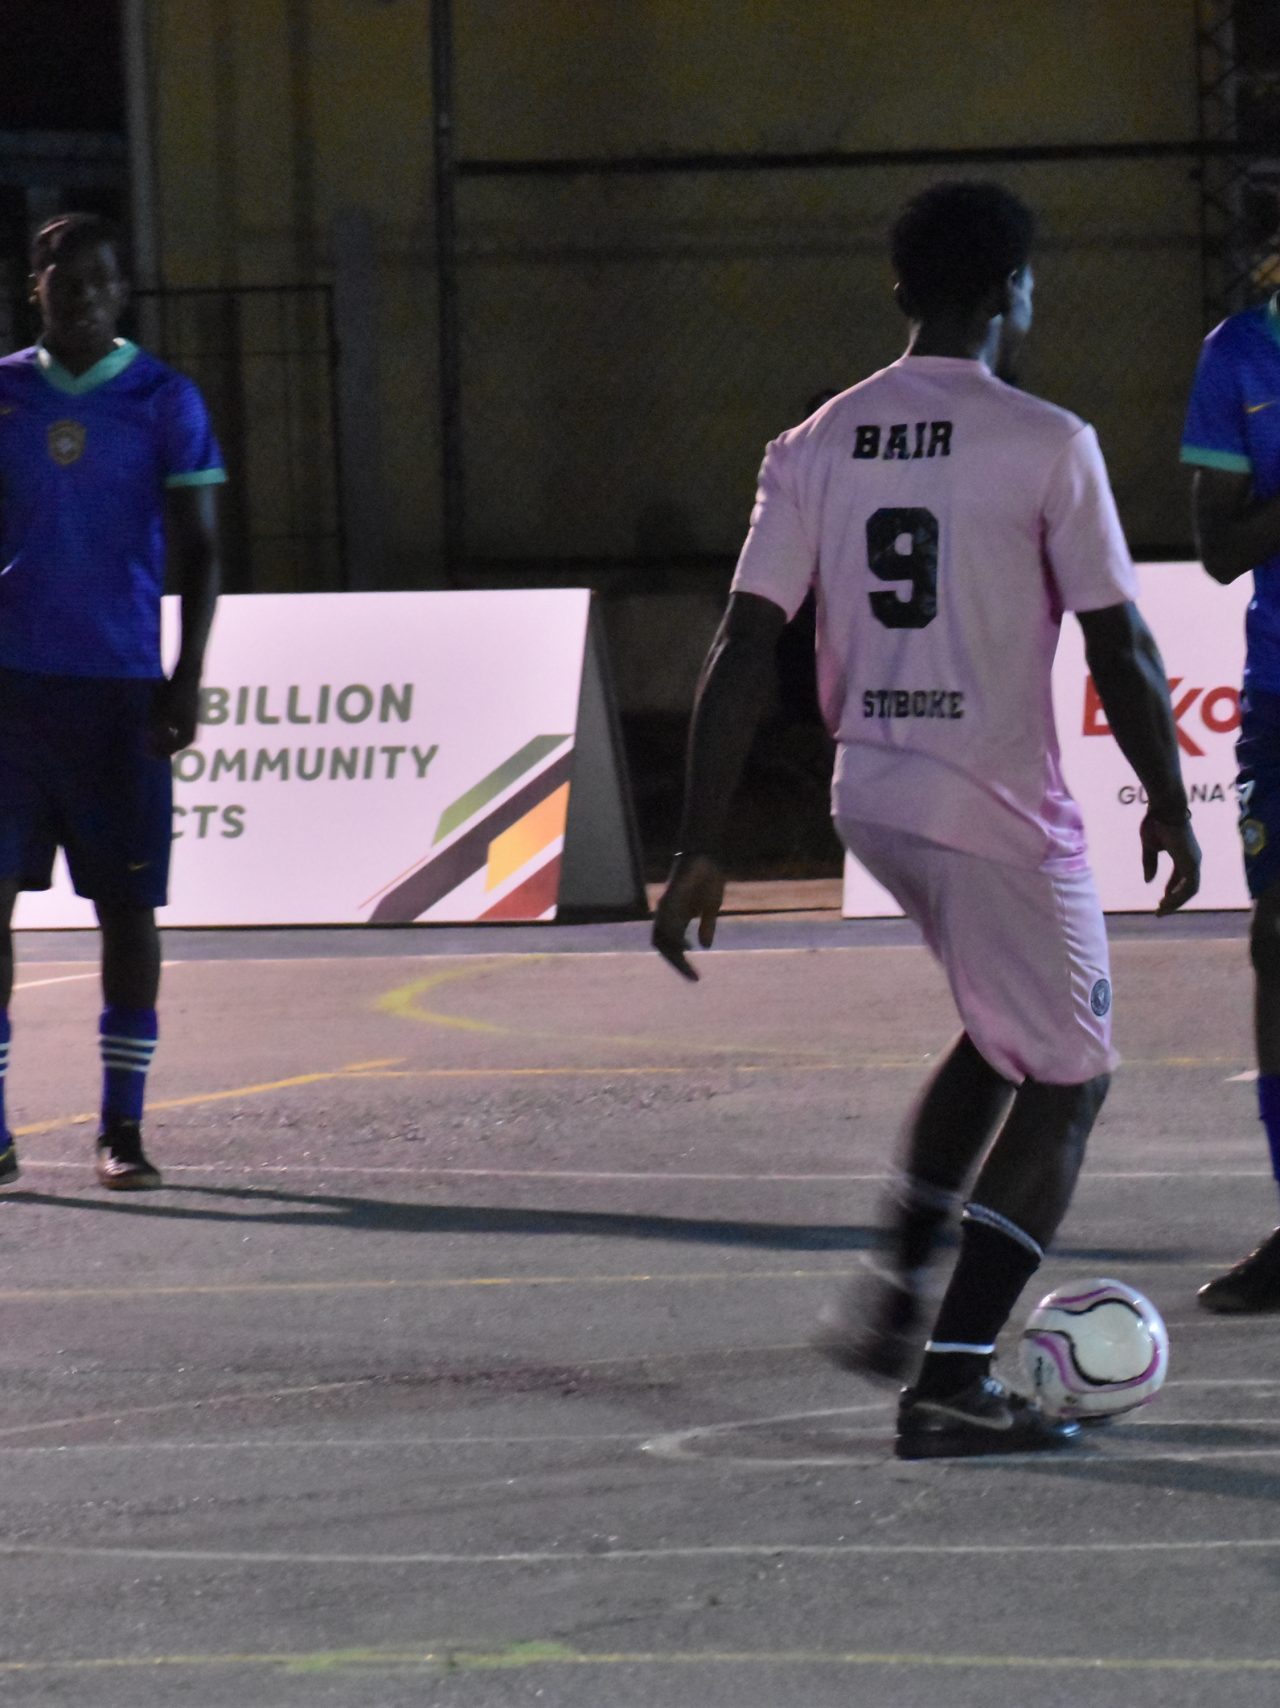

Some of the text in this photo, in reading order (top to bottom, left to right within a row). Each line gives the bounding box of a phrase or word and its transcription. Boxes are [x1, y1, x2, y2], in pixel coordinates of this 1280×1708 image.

[852, 421, 953, 460] BAIR
[866, 507, 939, 630] 9
[199, 683, 414, 726] BILLION
[172, 744, 439, 783] OMMUNITY
